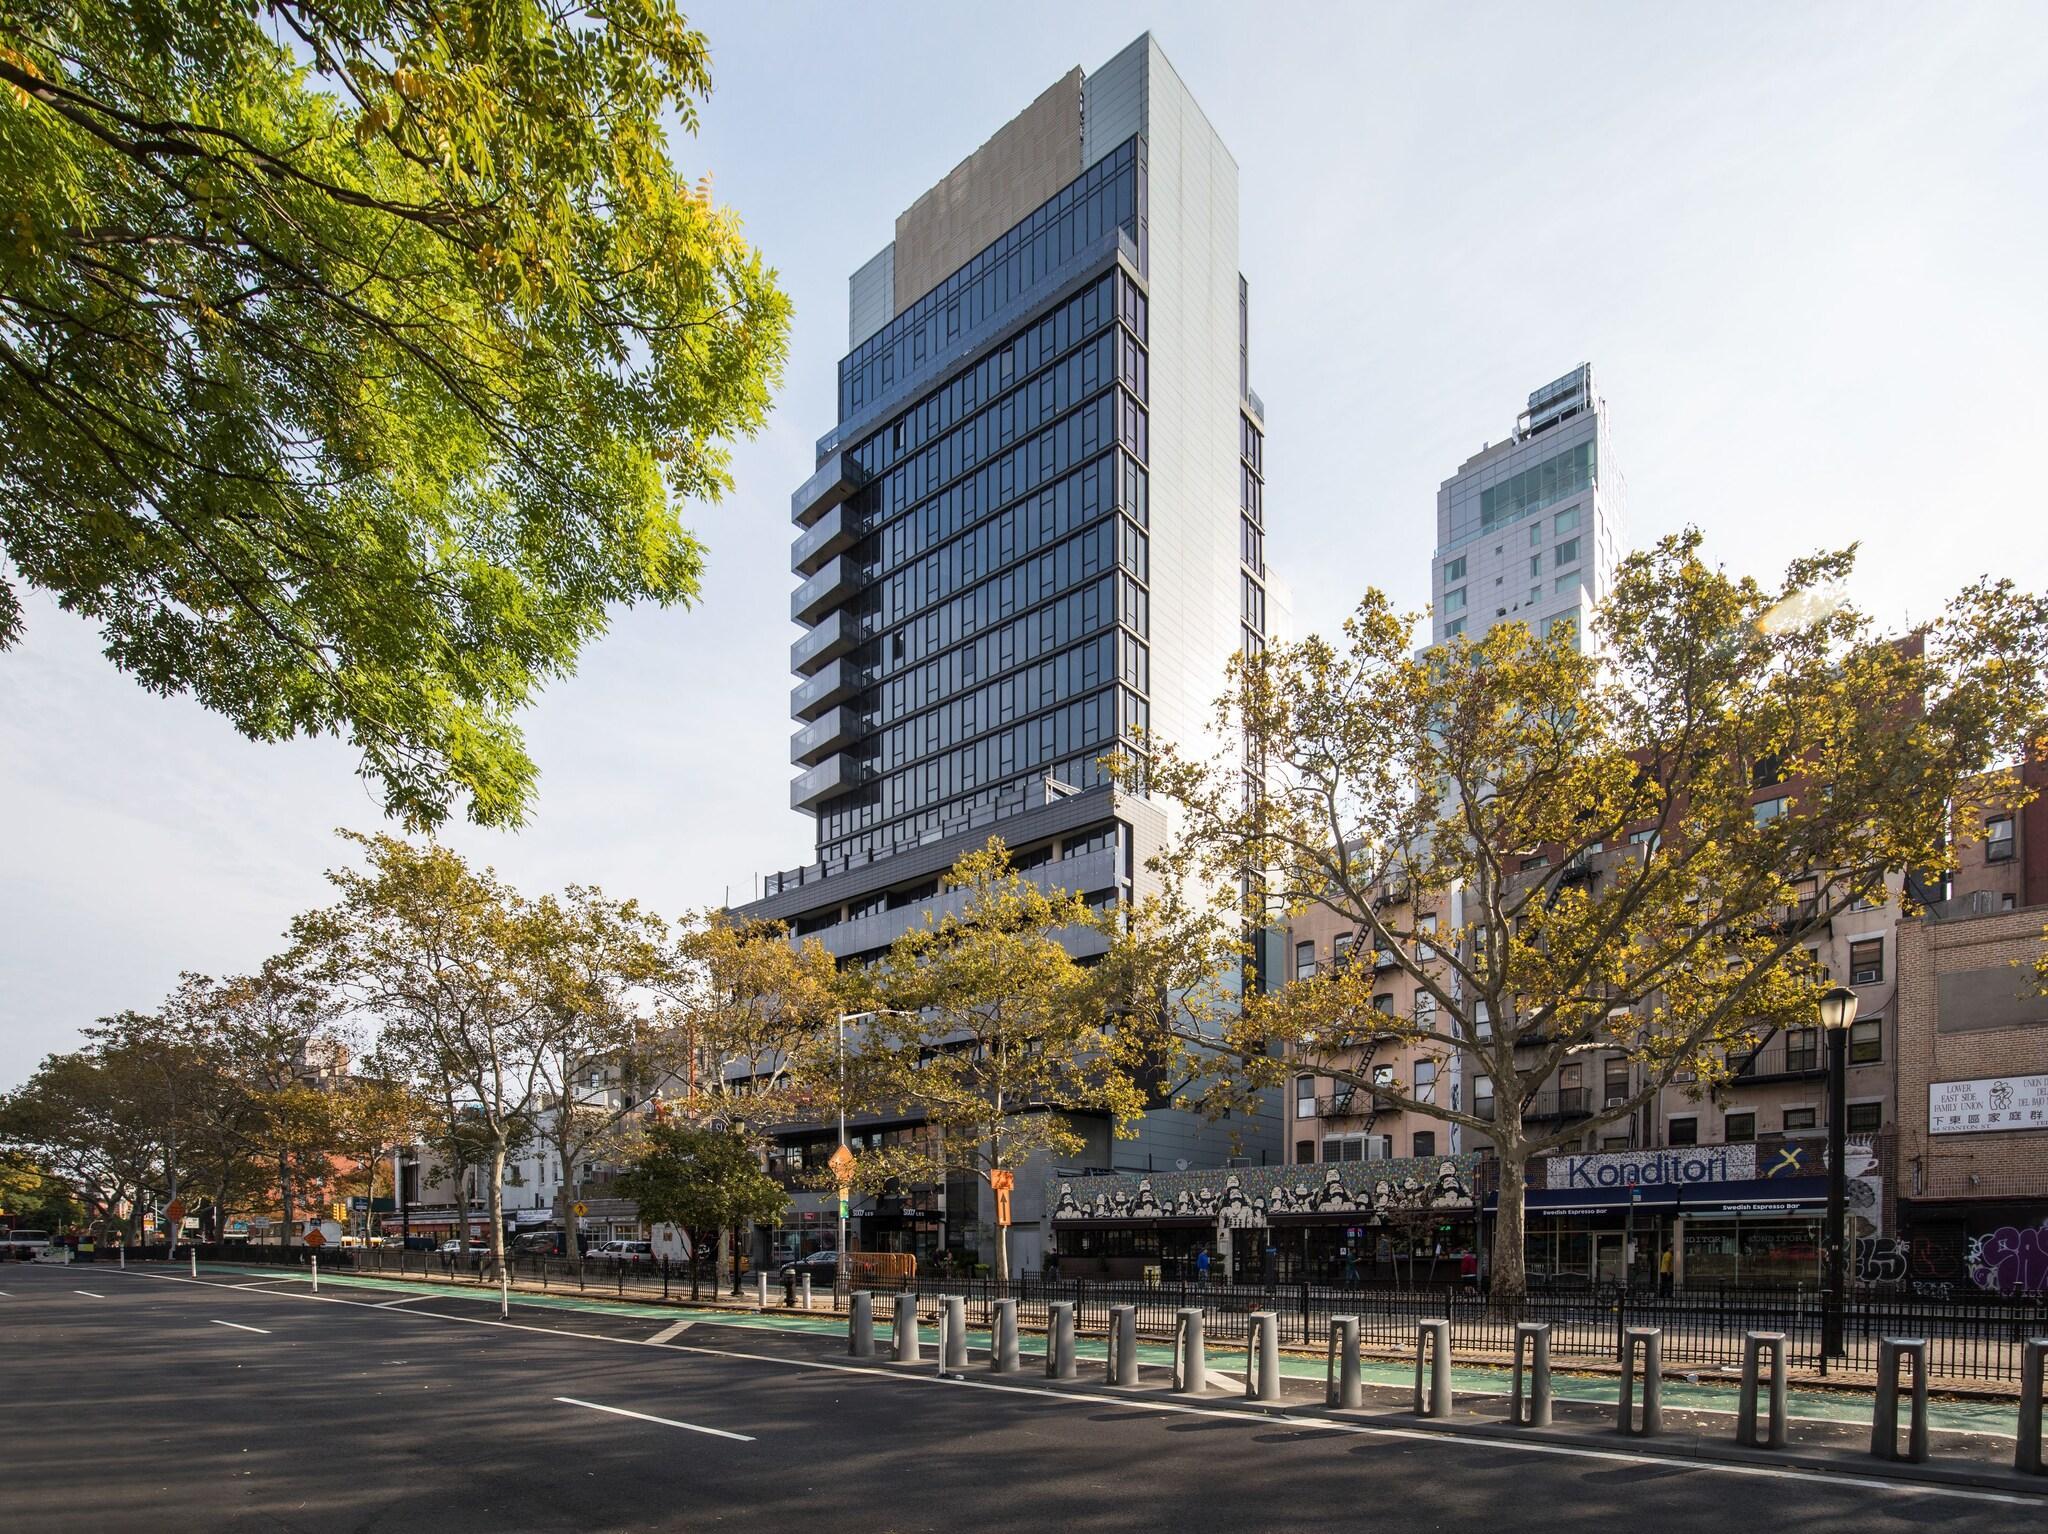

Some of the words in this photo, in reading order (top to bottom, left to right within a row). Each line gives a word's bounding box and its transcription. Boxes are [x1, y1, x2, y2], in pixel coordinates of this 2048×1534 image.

[1946, 1084, 1972, 1093] LOWER
[2023, 1079, 2042, 1088] UNION
[1941, 1094, 1959, 1103] EAST
[1961, 1092, 1976, 1101] SIDE
[2018, 1098, 2030, 1107] DEL
[1934, 1103, 1957, 1112] FAMILY
[1960, 1101, 1984, 1110] UNION
[1569, 1151, 1727, 1188] Konditori
